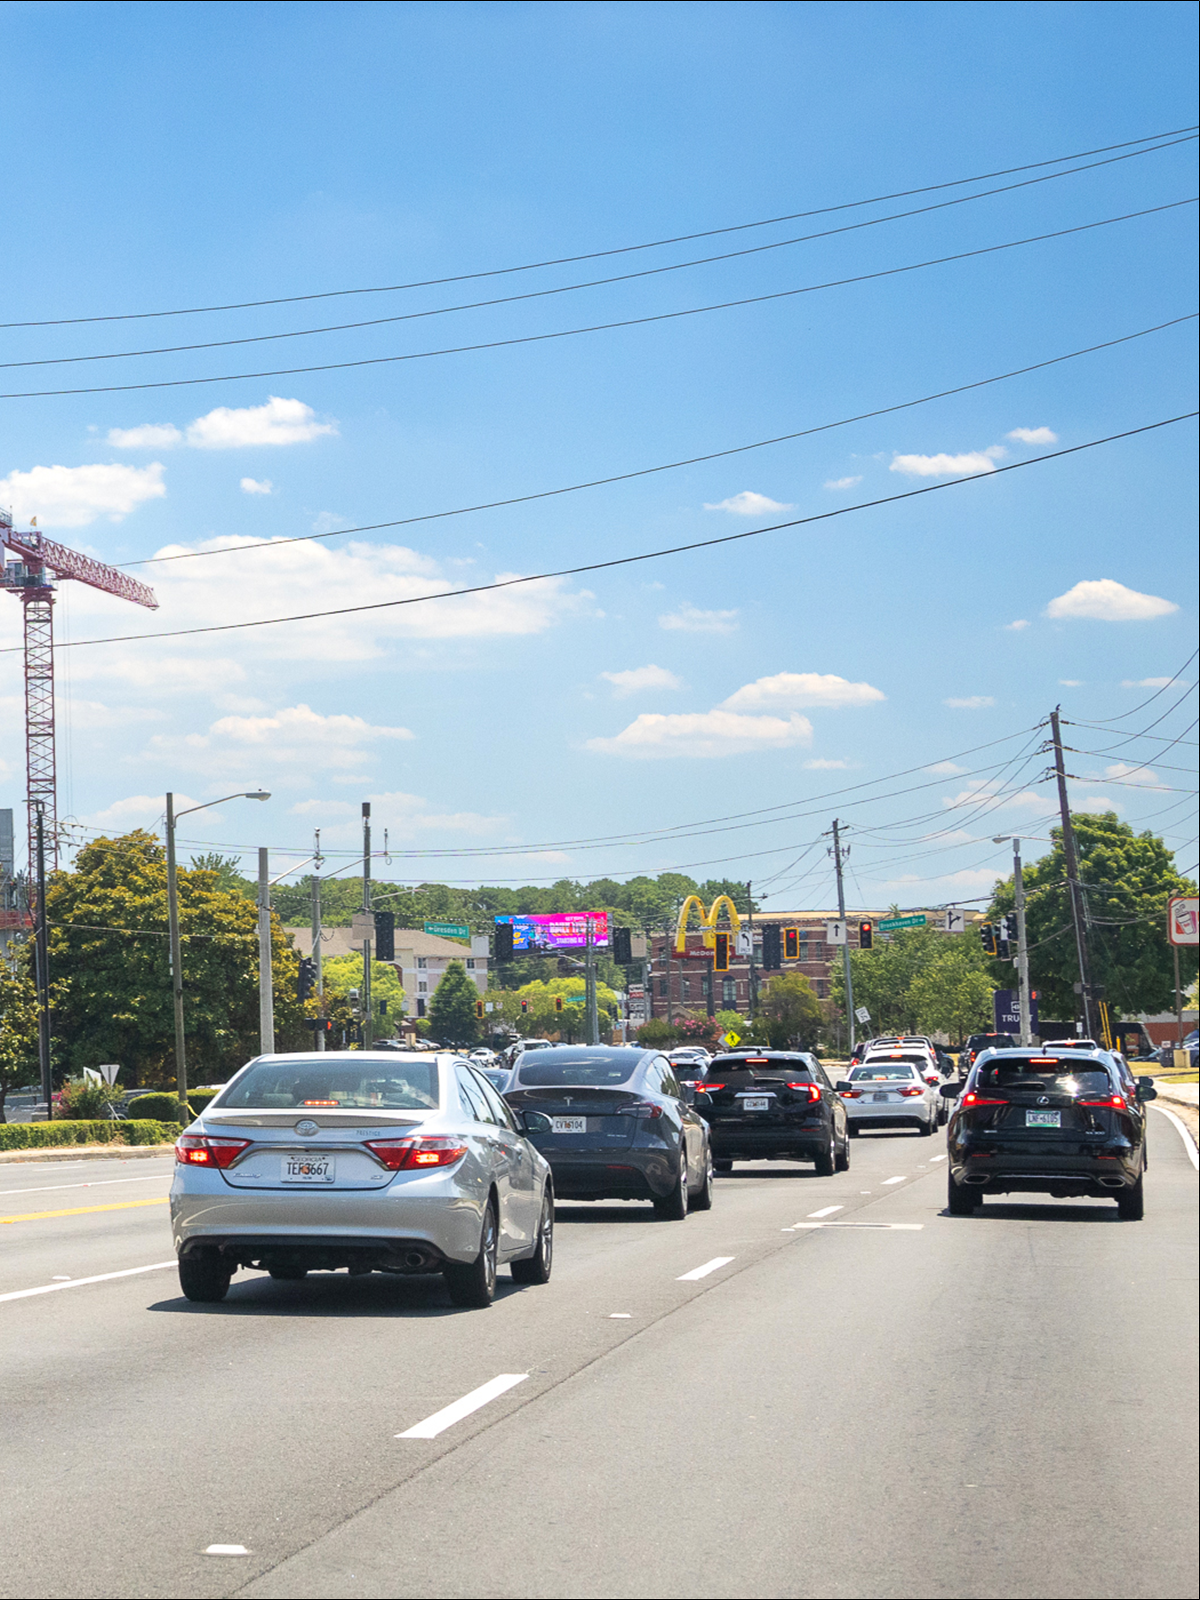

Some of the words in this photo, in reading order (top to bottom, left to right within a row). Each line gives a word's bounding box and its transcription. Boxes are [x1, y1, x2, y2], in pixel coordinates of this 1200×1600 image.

[880, 920, 911, 929] Brookhaven
[433, 925, 458, 934] Dresden
[1002, 1014, 1034, 1022] TRUT
